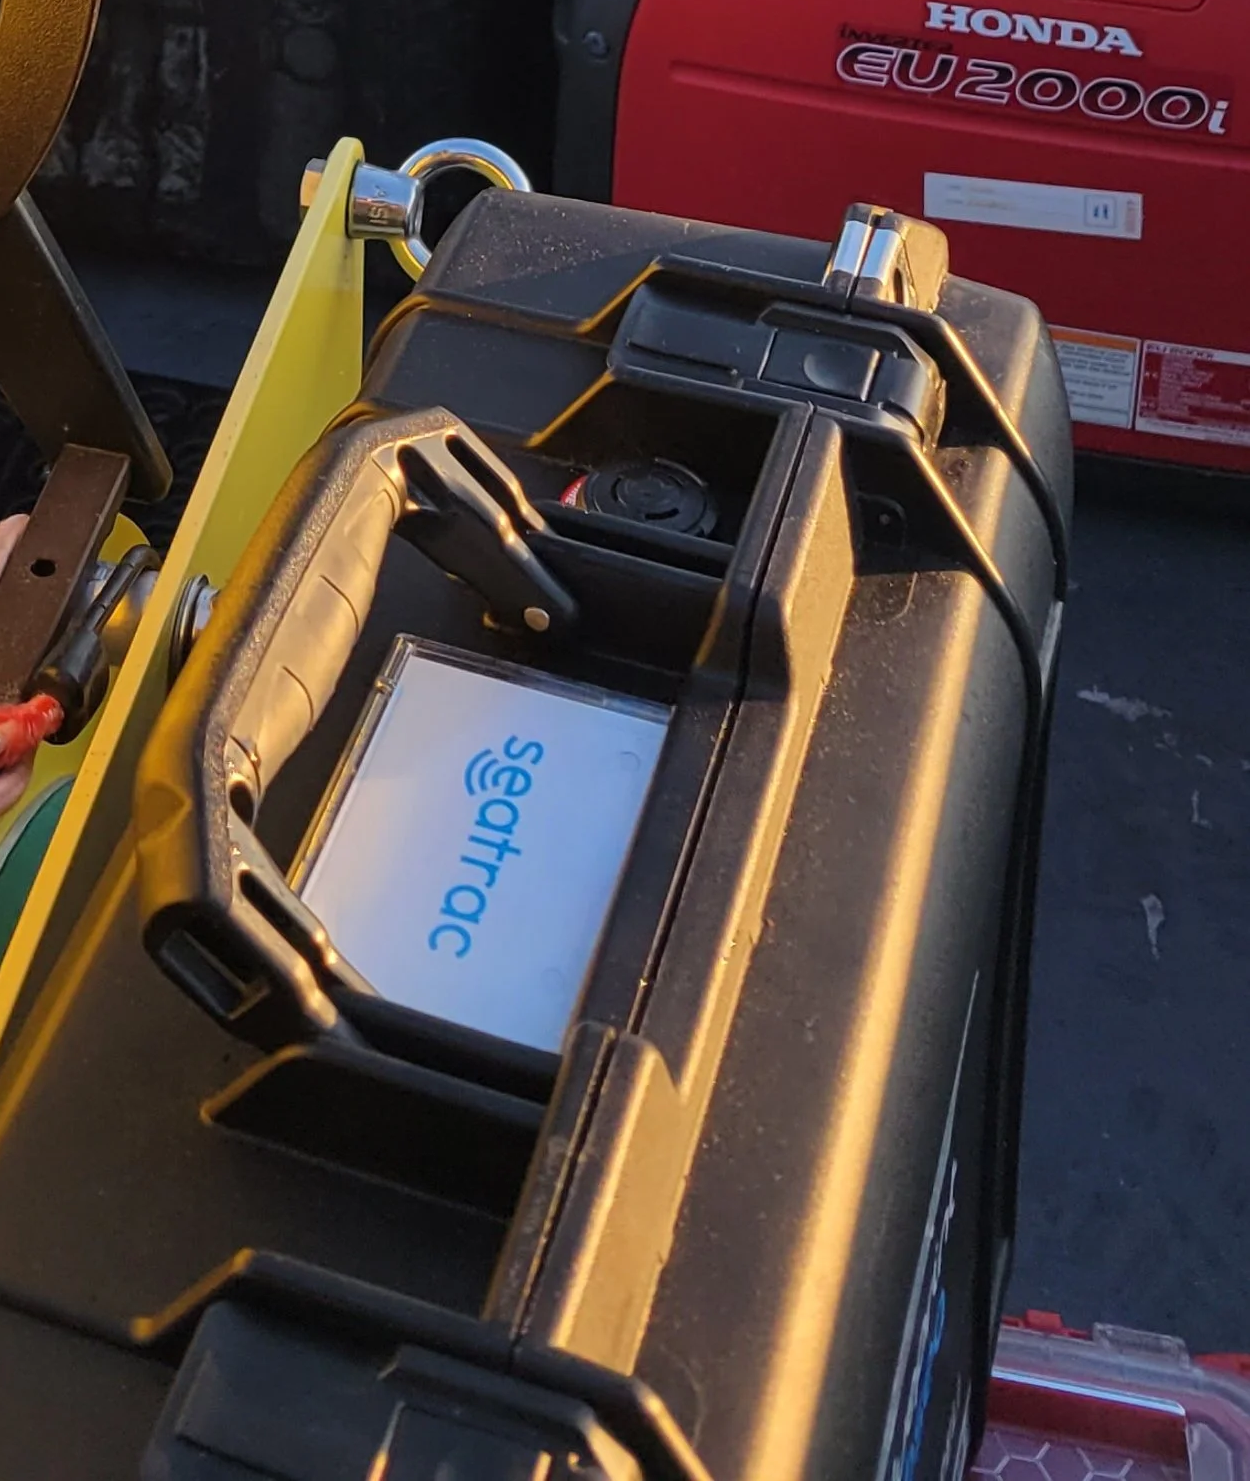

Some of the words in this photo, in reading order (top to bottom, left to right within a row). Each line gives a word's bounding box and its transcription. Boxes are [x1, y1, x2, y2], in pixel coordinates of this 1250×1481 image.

[924, 1, 1144, 58] HONDA
[835, 41, 1231, 136] EU2000i
[427, 734, 545, 960] seatrac
